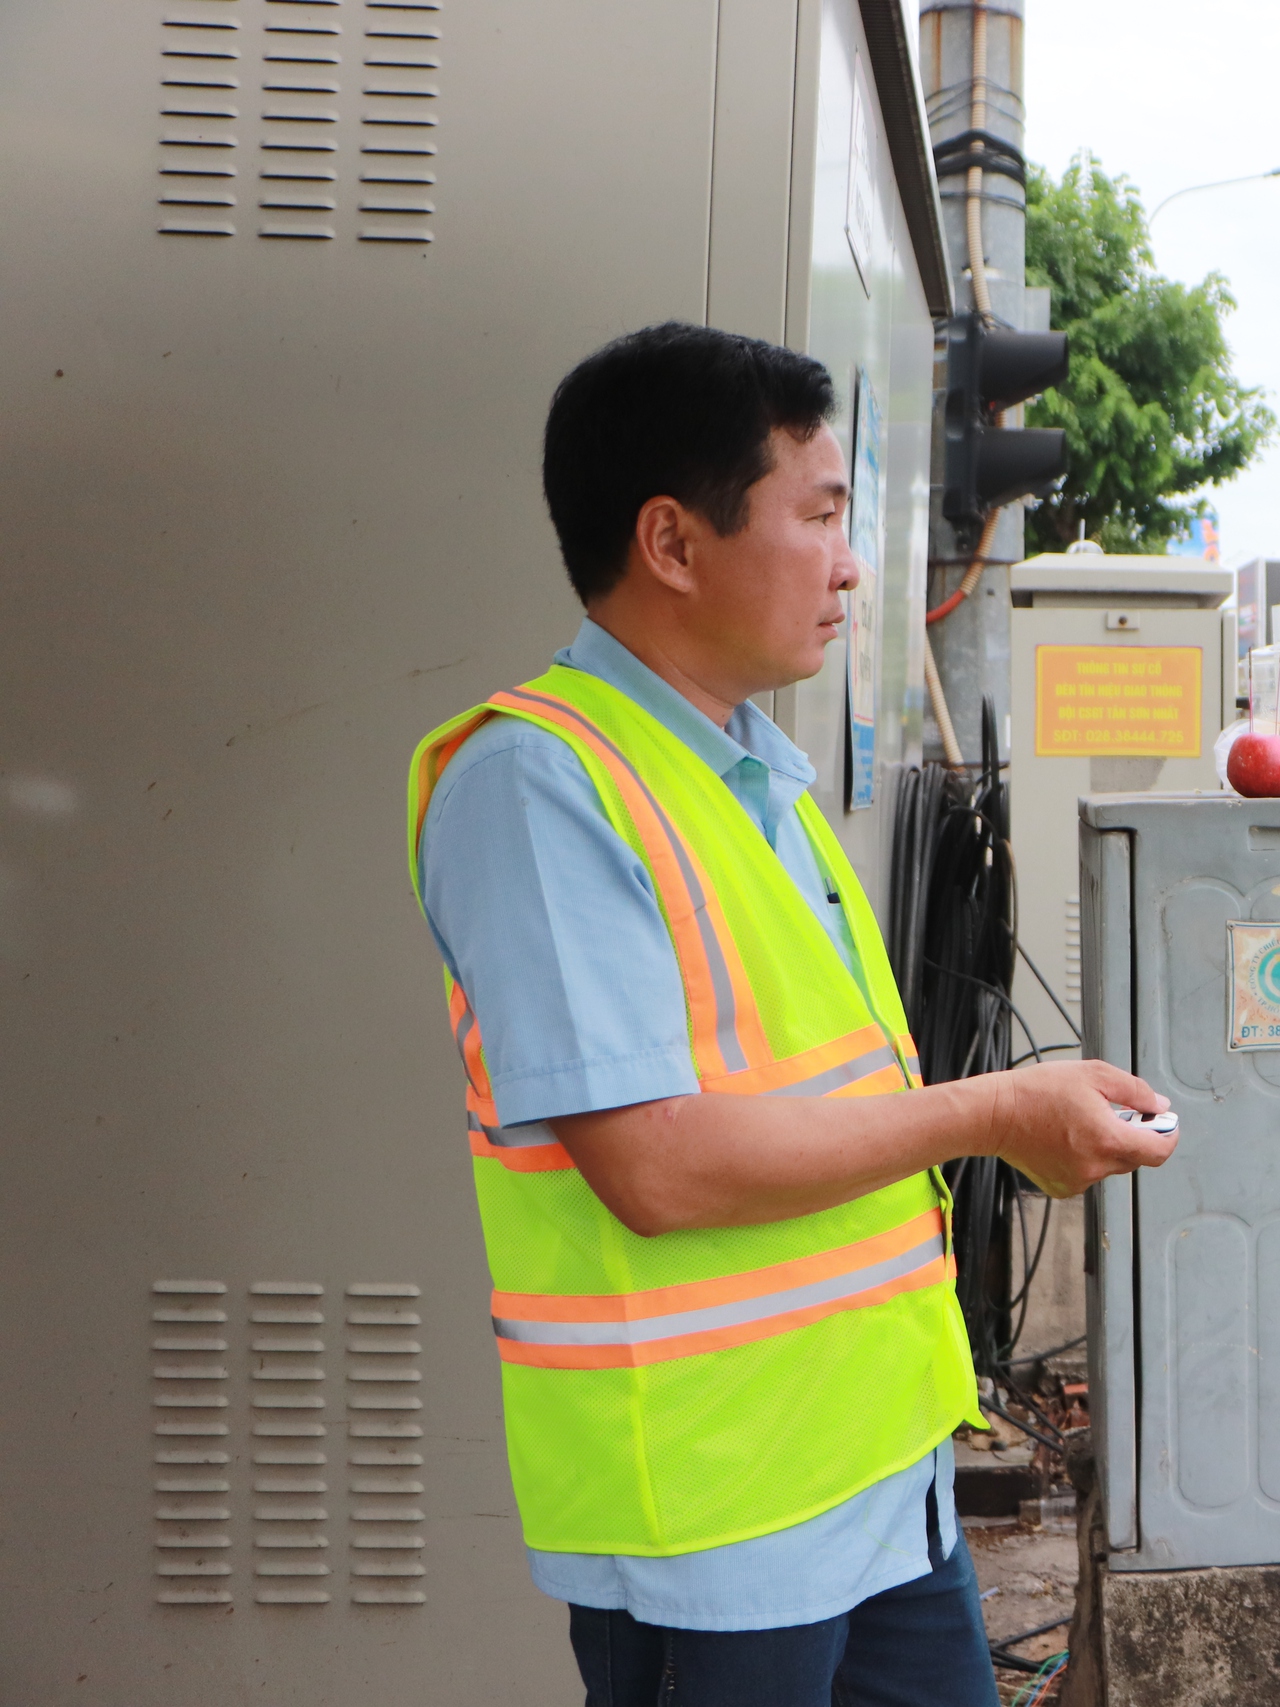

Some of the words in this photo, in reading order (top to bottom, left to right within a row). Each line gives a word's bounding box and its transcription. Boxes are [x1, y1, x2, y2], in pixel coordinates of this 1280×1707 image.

[1076, 659, 1110, 675] THÔNG
[1112, 662, 1129, 675] TIN
[1131, 661, 1146, 677] SỰ
[1148, 658, 1163, 675] CỐ
[1097, 682, 1121, 699] HIỆU
[1123, 684, 1147, 698] GIAO
[1150, 682, 1183, 698] THÔNG
[1078, 706, 1104, 719] CSGT
[1241, 1025, 1263, 1038] ĐT:
